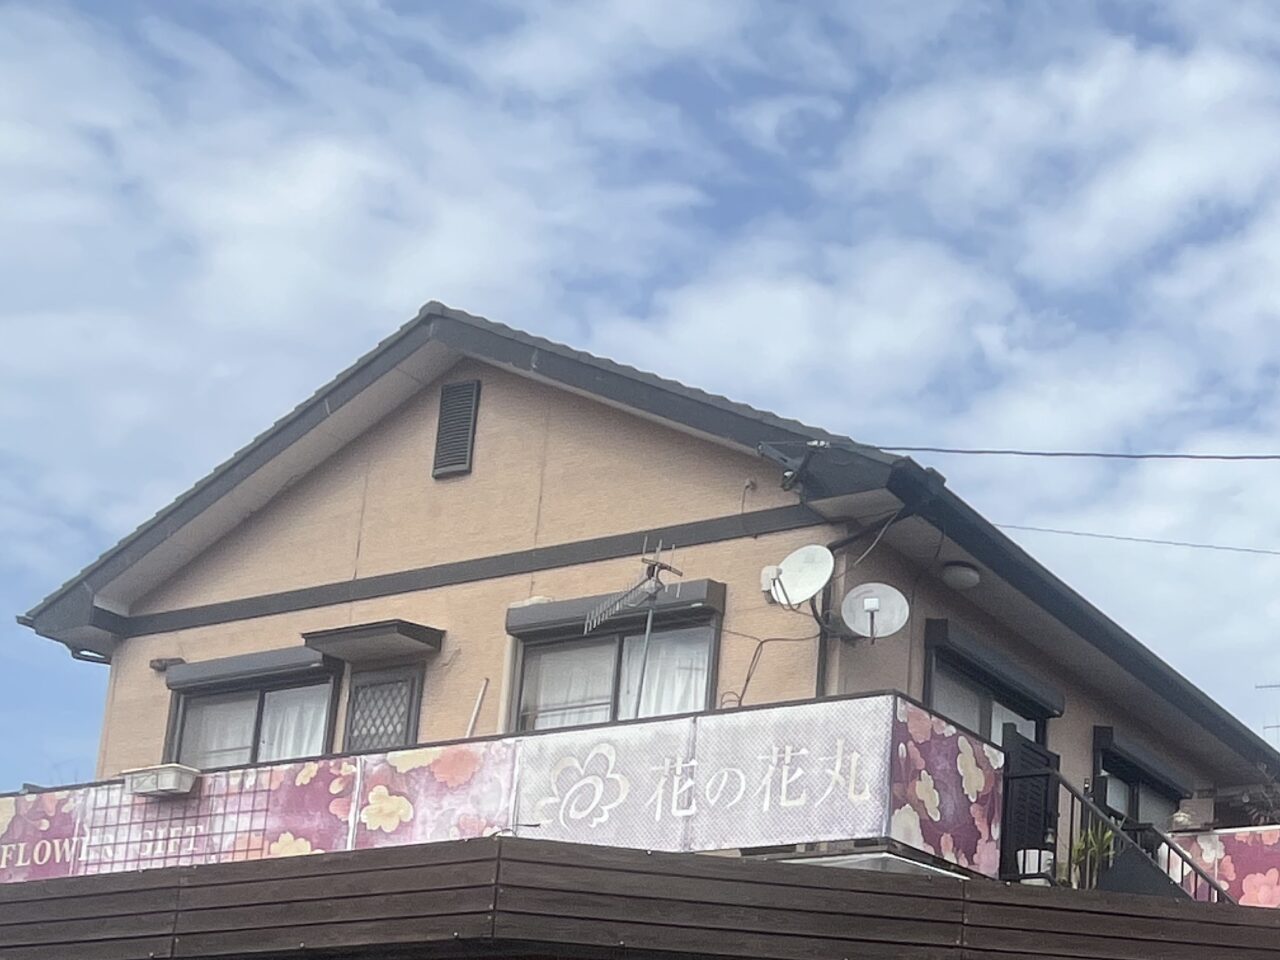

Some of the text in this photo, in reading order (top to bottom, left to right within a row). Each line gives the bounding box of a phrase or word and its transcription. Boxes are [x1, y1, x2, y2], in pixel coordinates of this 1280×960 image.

[650, 737, 871, 822] 花の花丸
[0, 824, 204, 869] FLOWER GIFT
